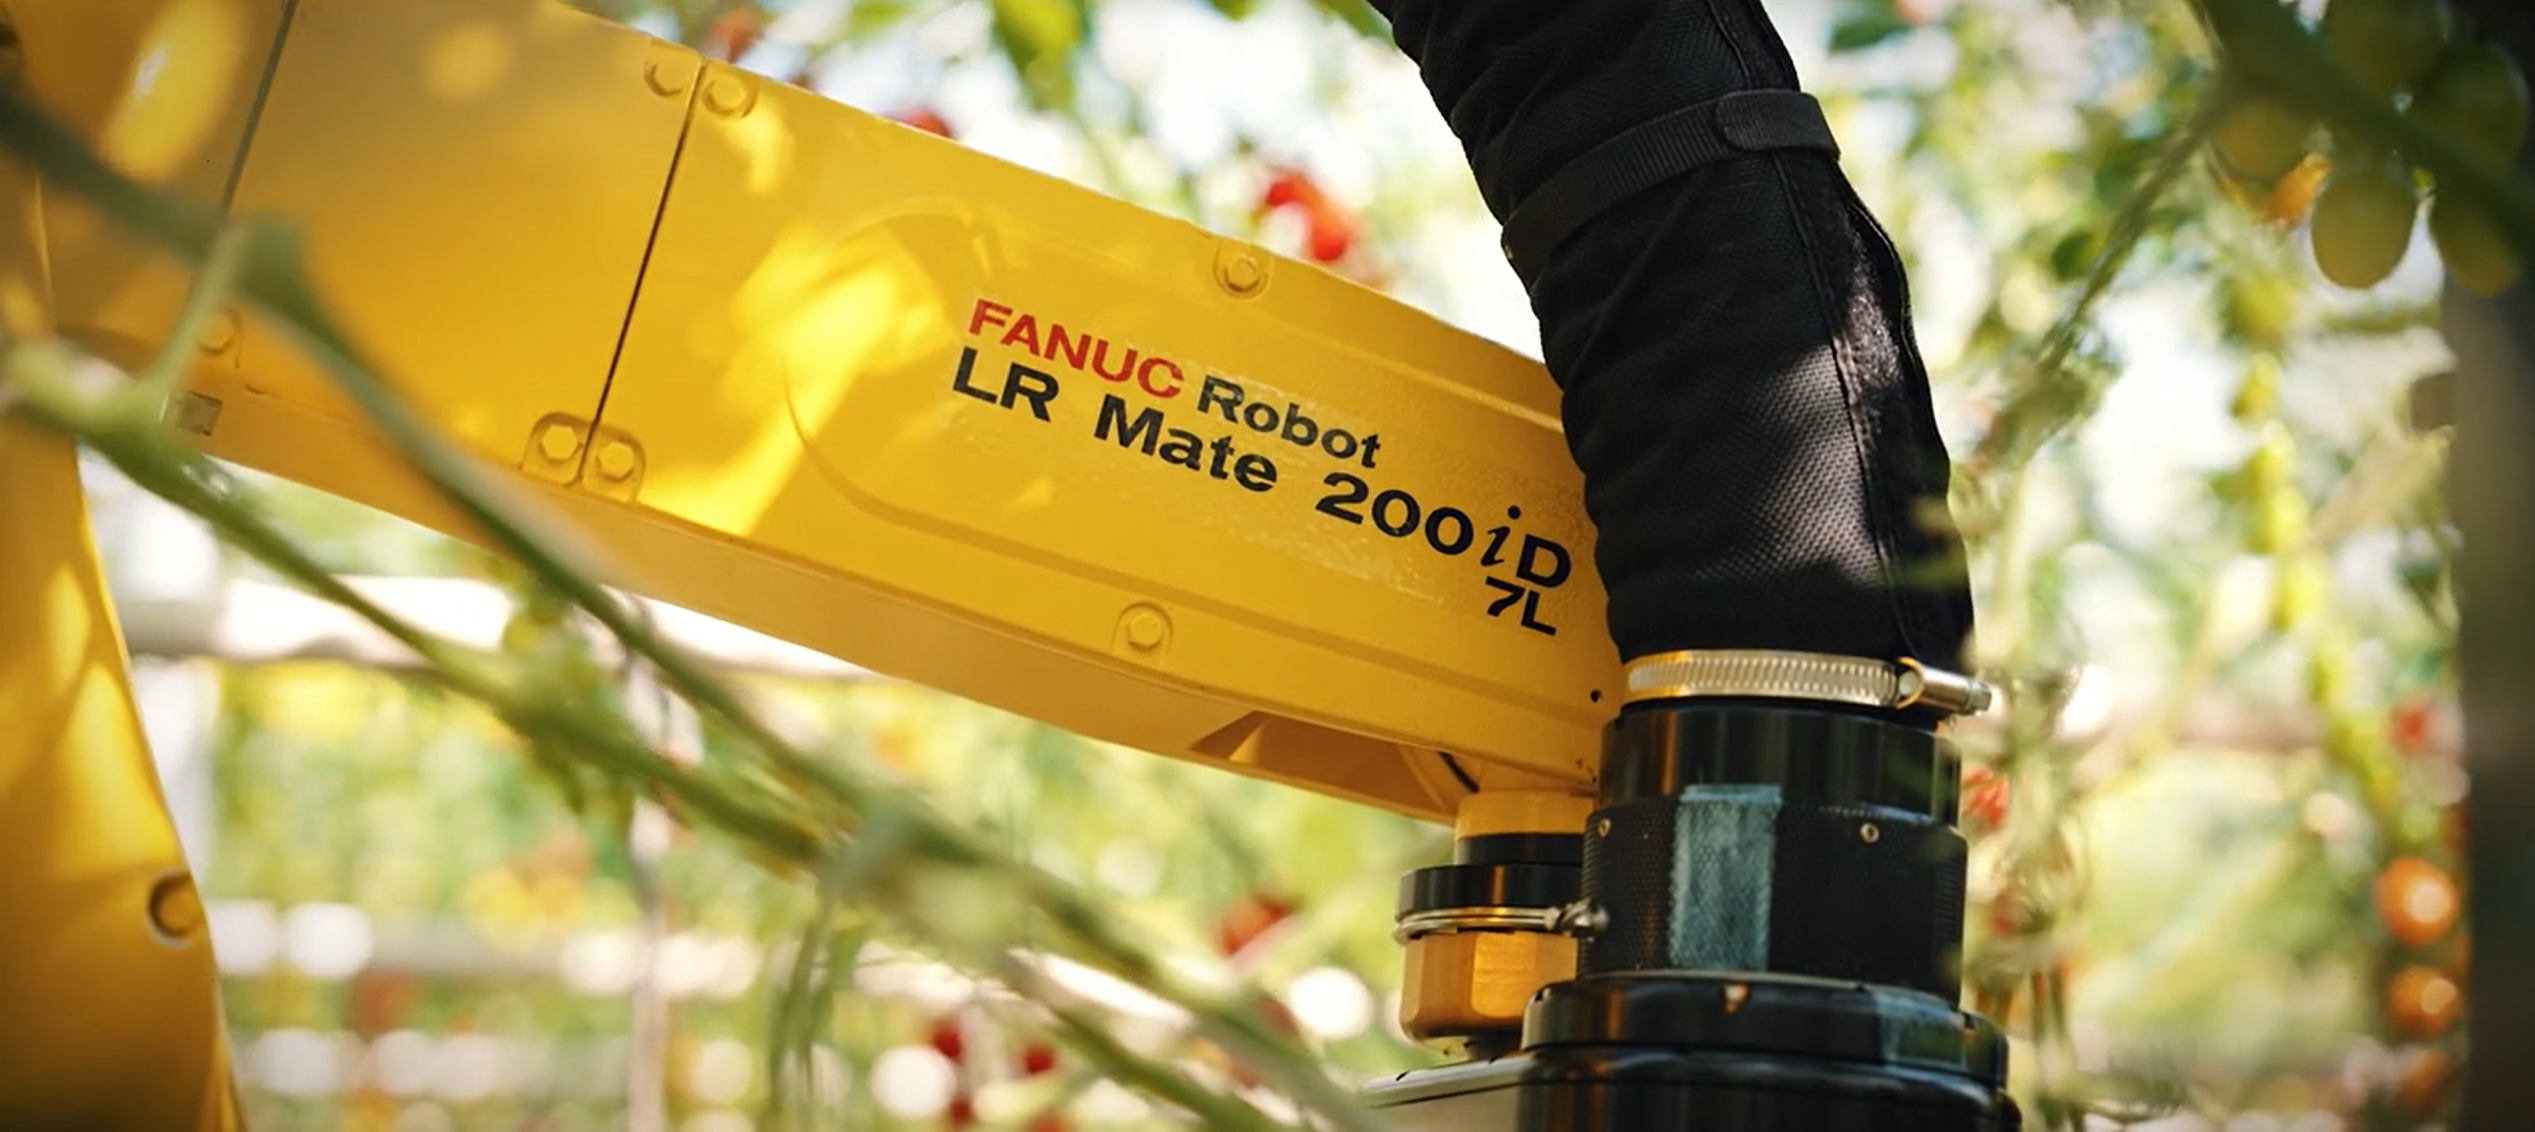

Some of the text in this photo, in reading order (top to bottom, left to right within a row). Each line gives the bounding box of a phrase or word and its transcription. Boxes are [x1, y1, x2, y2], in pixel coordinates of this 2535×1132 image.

[952, 347, 1060, 422] LR
[1094, 394, 1278, 493] Mate
[968, 299, 1381, 469] FANUC Robot
[1485, 576, 1558, 636] 7L
